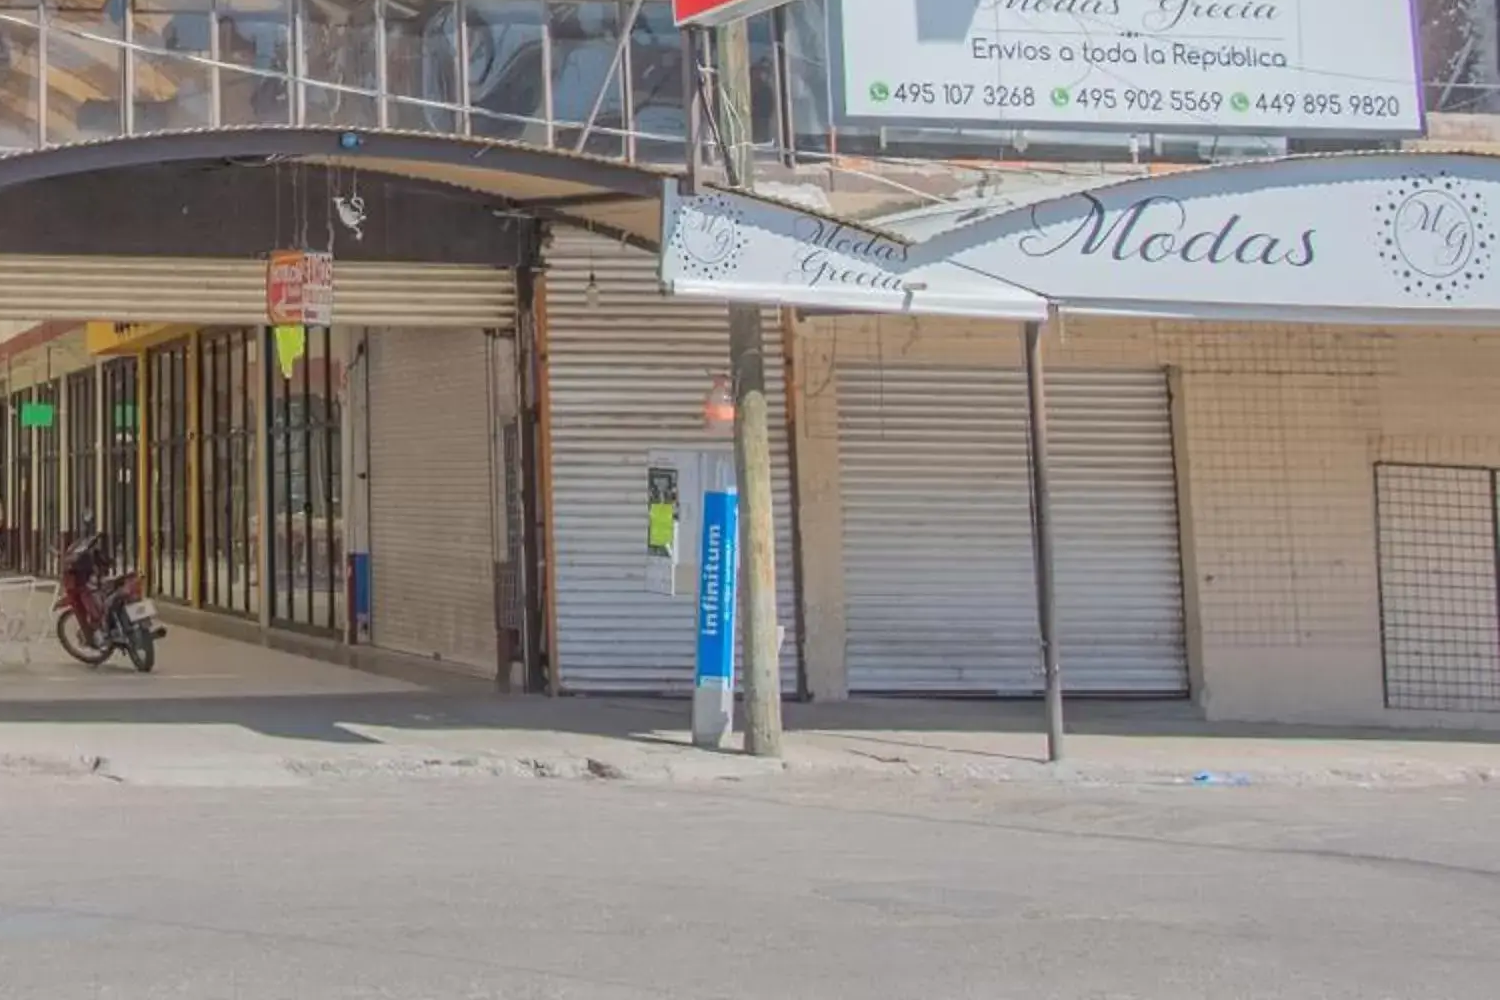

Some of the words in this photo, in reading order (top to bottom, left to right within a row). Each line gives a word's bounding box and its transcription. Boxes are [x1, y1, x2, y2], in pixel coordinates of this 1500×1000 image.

[1059, 45, 1074, 61] a
[1083, 40, 1137, 64] toda
[1144, 43, 1167, 66] la
[1173, 45, 1288, 72] República
[894, 84, 936, 105] 495
[943, 84, 975, 106] 107
[984, 85, 1036, 108] 3268
[1076, 88, 1117, 109] 495
[1123, 90, 1163, 111] 902
[1170, 90, 1224, 112] 5569
[1255, 93, 1297, 113] 449
[1303, 94, 1342, 115] 895
[1350, 95, 1400, 117] 9820
[796, 216, 909, 262] Modas
[1019, 192, 1316, 267] Modas
